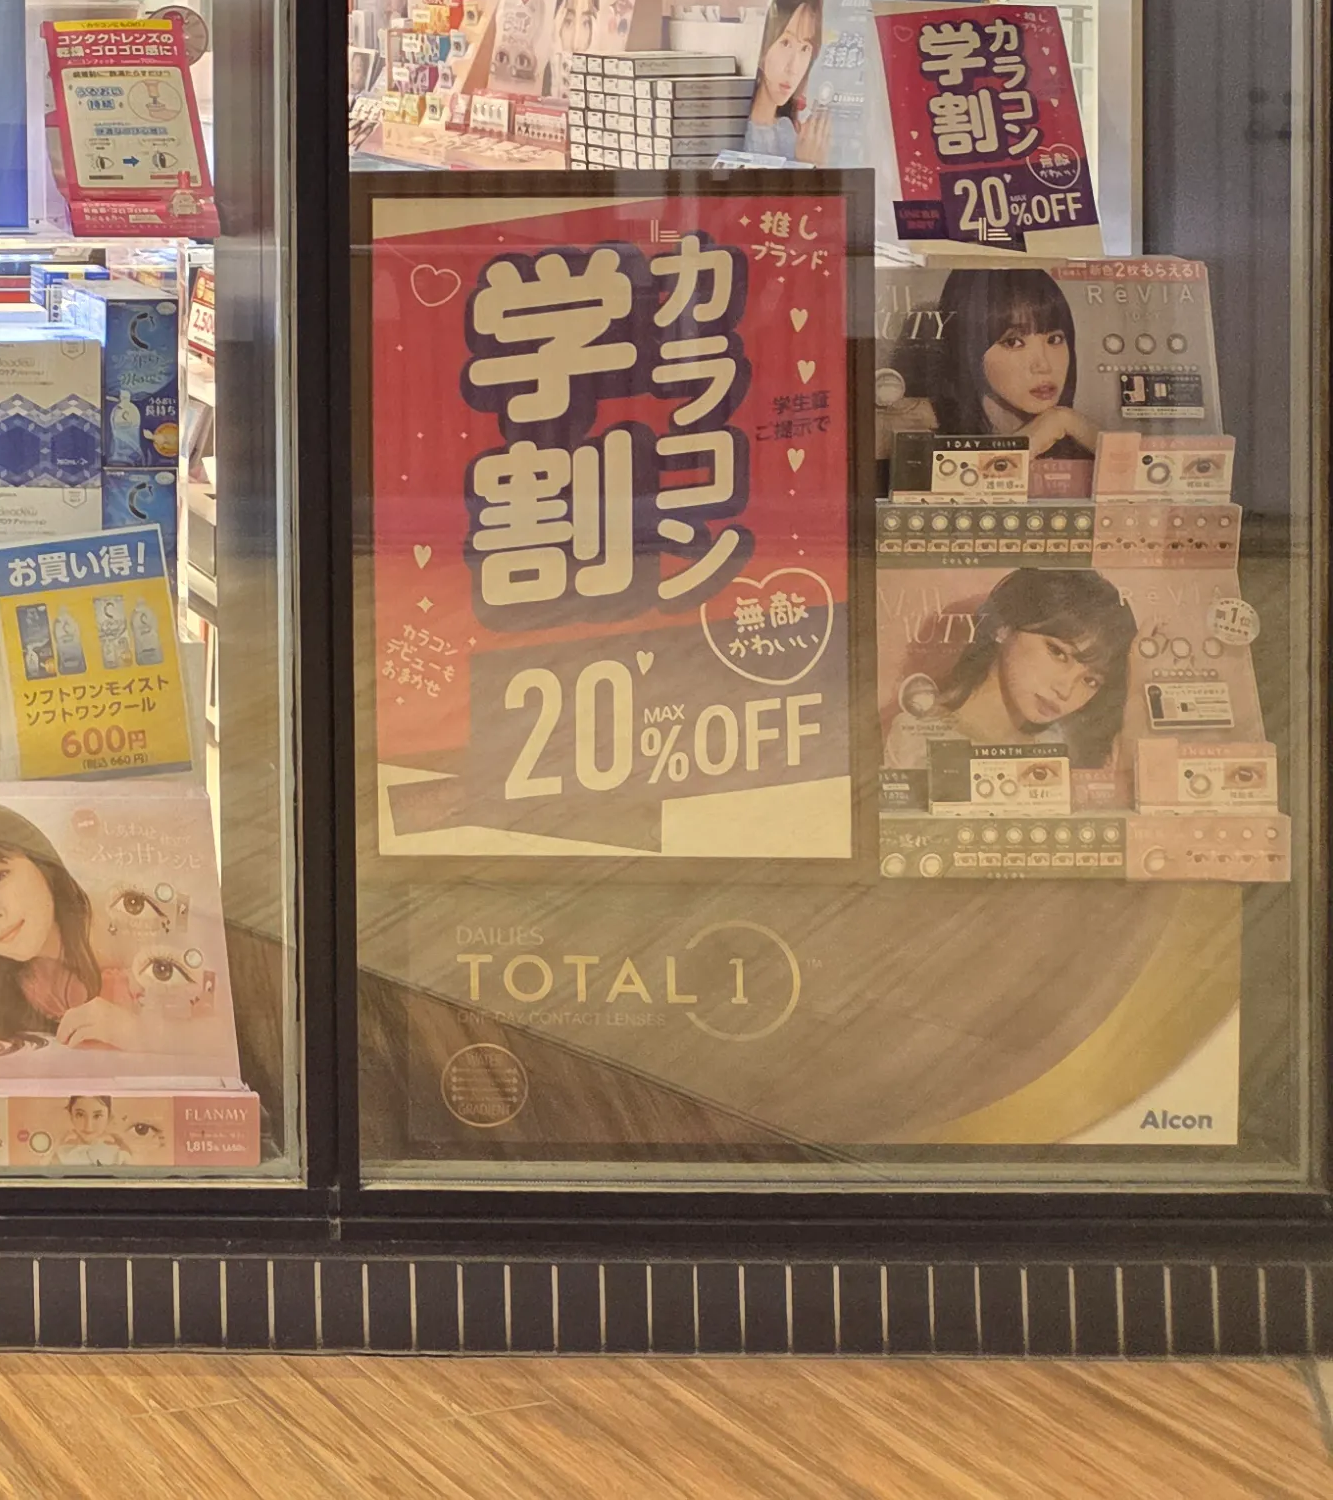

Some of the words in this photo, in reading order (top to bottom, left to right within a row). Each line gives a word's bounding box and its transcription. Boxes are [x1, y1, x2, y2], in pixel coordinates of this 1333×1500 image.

[57, 33, 174, 45] コンタクトレンズの
[919, 21, 999, 156] 学割
[984, 19, 1039, 156] カラコン
[759, 210, 819, 241] 推し
[750, 243, 830, 272] ブランド
[468, 247, 638, 606] 学割
[649, 234, 740, 600] カラコン
[7, 541, 146, 588] お買い得!
[733, 591, 809, 631] 無敵
[401, 623, 459, 656] カラコン
[728, 633, 819, 658] かわいい
[385, 638, 458, 683] デビューも
[23, 674, 169, 708] ソフトワンモイスト
[381, 660, 442, 698] おまかせ
[26, 696, 156, 726] ソフトワンクール
[644, 703, 686, 725] MAX
[60, 724, 147, 759] 600円
[456, 925, 545, 946] DAILIES
[456, 953, 698, 1004] TOTAL
[531, 1012, 601, 1027] CONTACT
[607, 1012, 666, 1027] LENSES
[184, 1107, 249, 1122] FLANMY
[1139, 1108, 1214, 1130] Alcon
